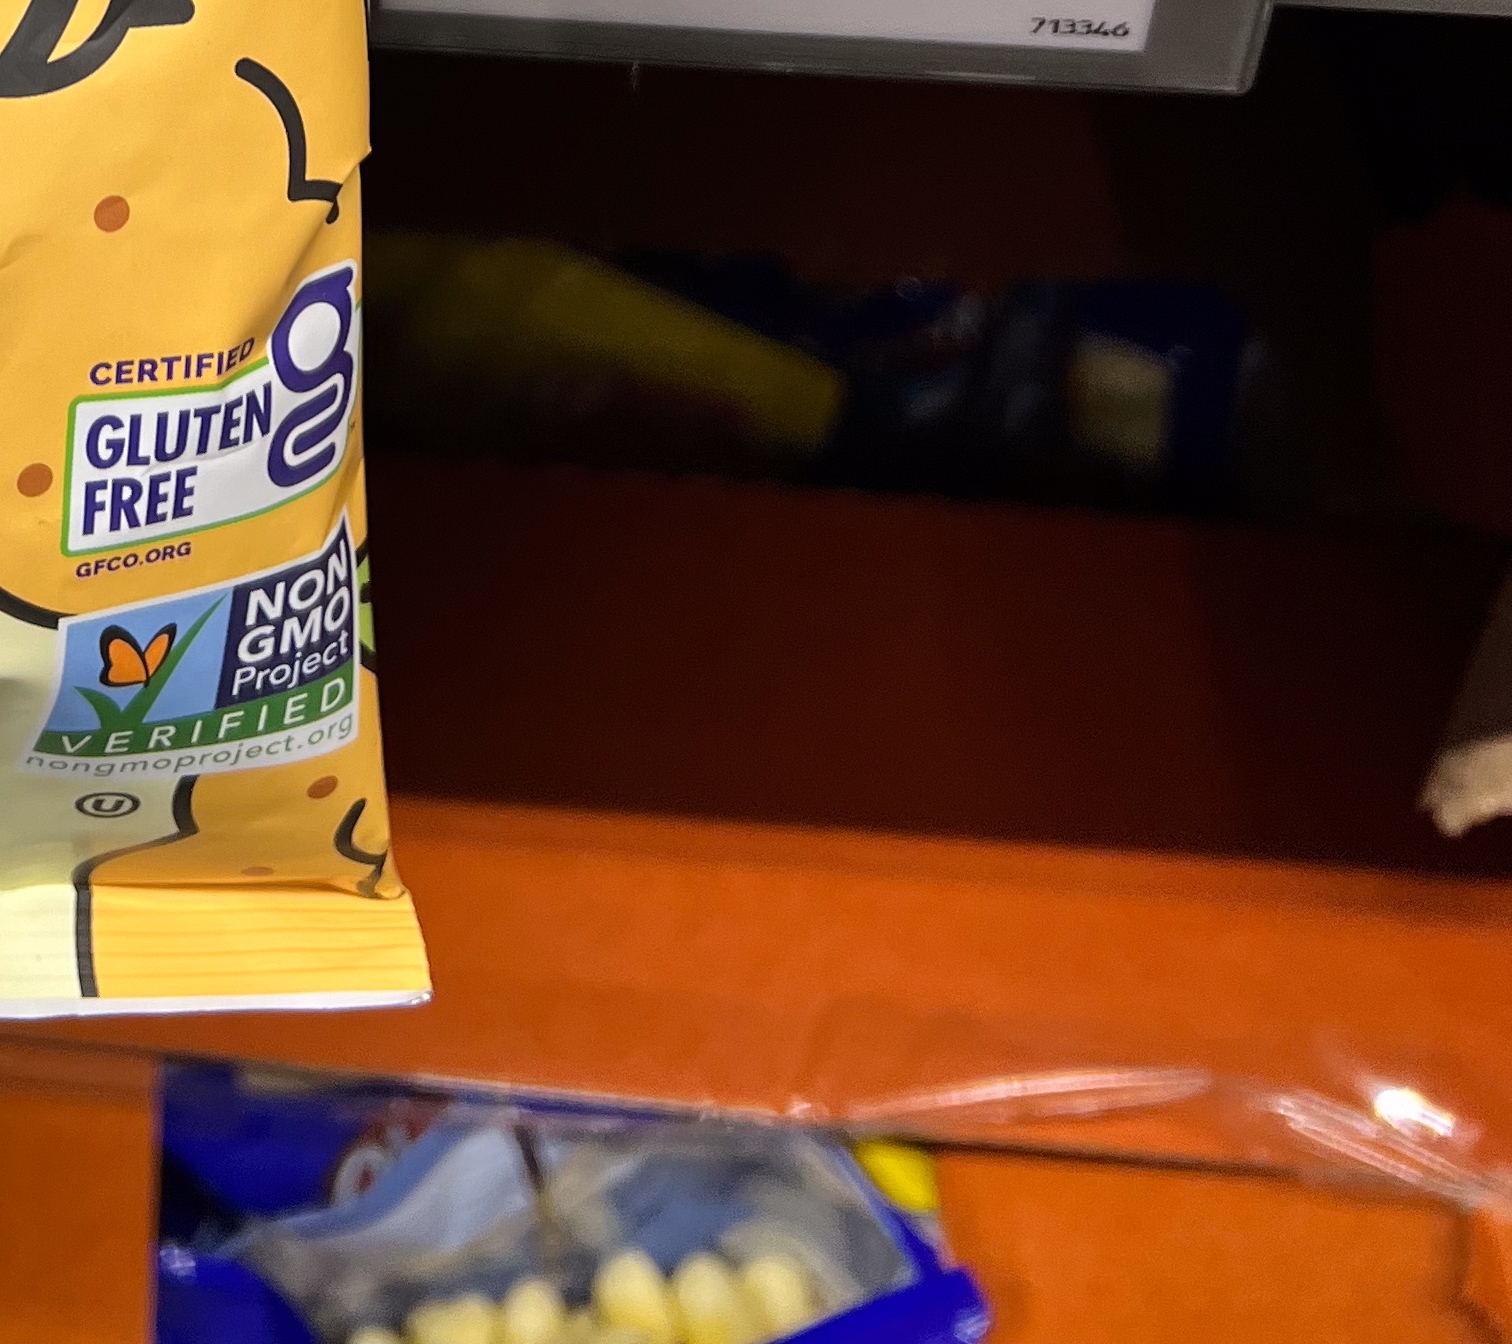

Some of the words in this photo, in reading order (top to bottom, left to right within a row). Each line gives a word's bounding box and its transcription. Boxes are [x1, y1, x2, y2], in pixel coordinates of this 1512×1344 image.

[88, 336, 256, 387] CERTIFIED
[84, 379, 274, 470] GLUTEN
[81, 465, 199, 537] FREE
[74, 540, 193, 579] GFCO.ORG
[243, 537, 348, 628] NON
[236, 585, 352, 664] GMO
[230, 629, 350, 698] Project
[25, 712, 355, 778] nongmoproject.org
[59, 677, 346, 755] VERIFIED
